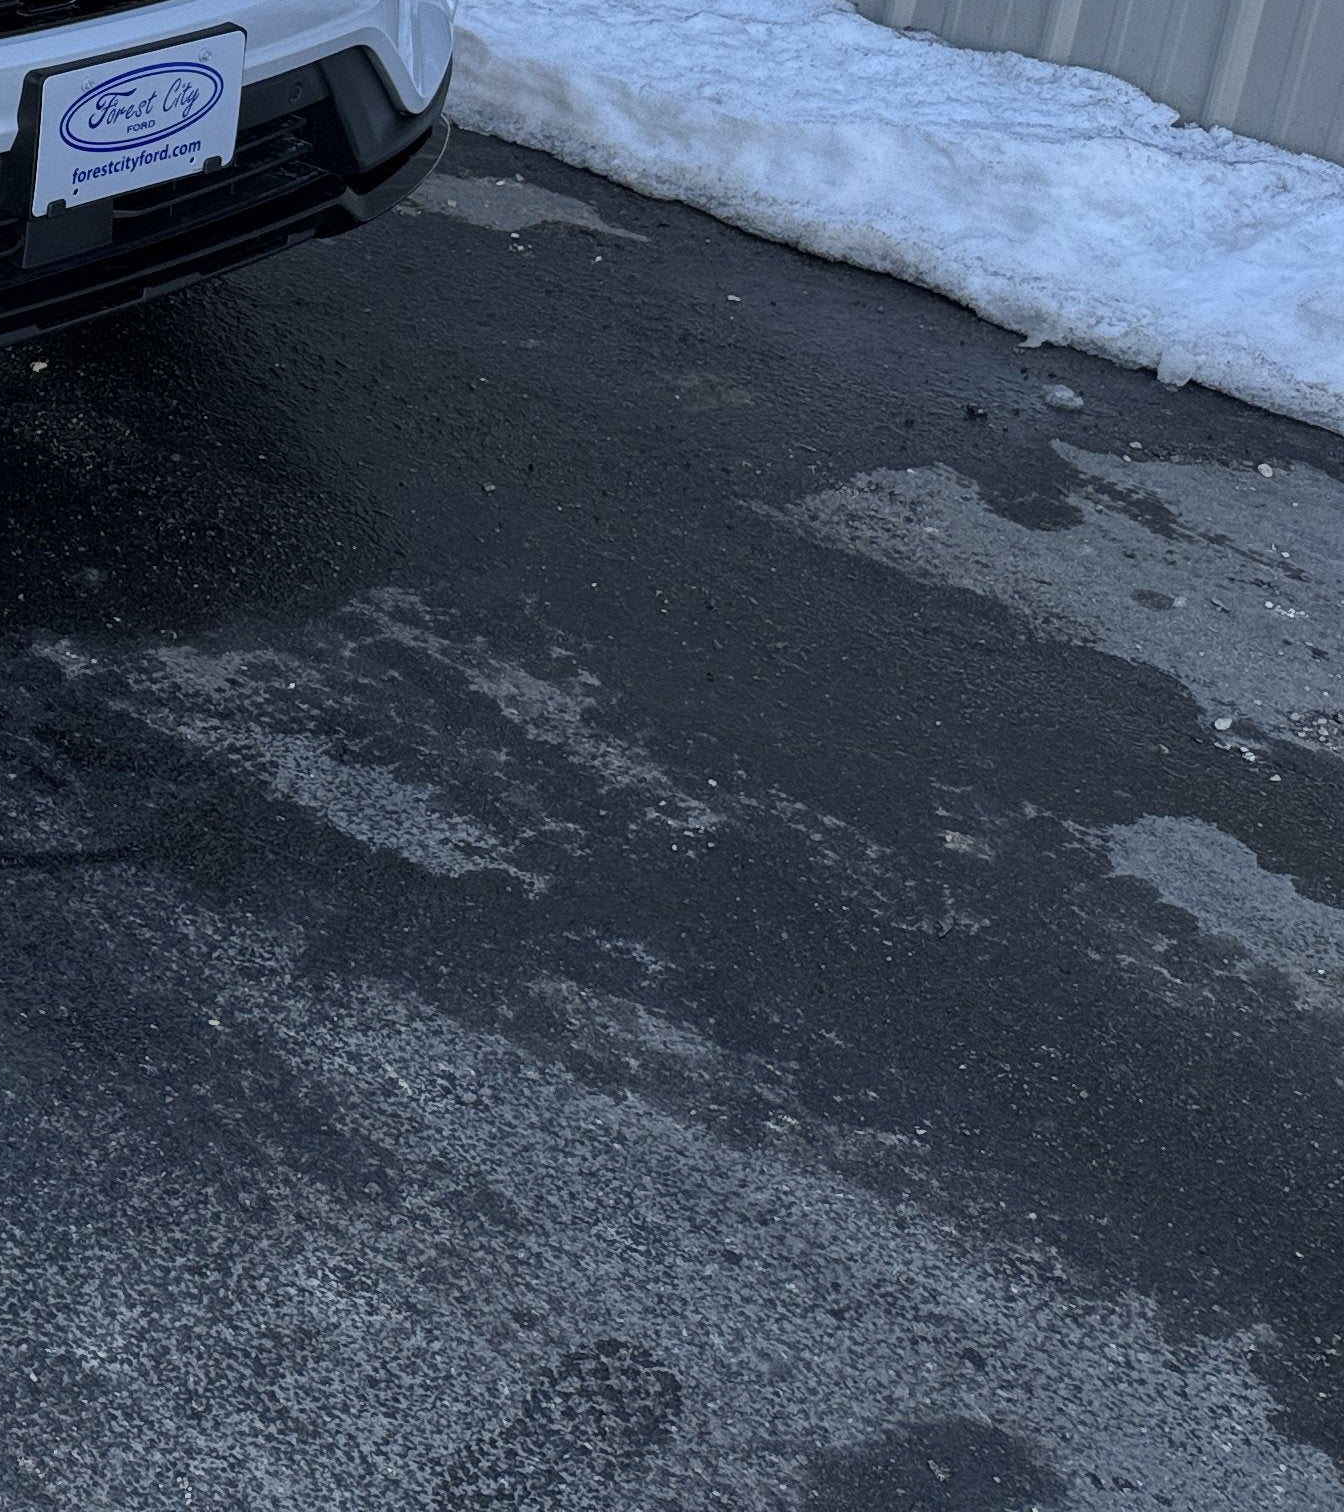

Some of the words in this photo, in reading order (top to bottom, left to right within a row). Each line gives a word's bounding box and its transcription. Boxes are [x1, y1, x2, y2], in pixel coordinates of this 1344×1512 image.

[88, 87, 156, 130] Forest
[163, 77, 200, 119] City
[126, 119, 156, 134] FORD
[71, 139, 202, 185] forestcityford.com
